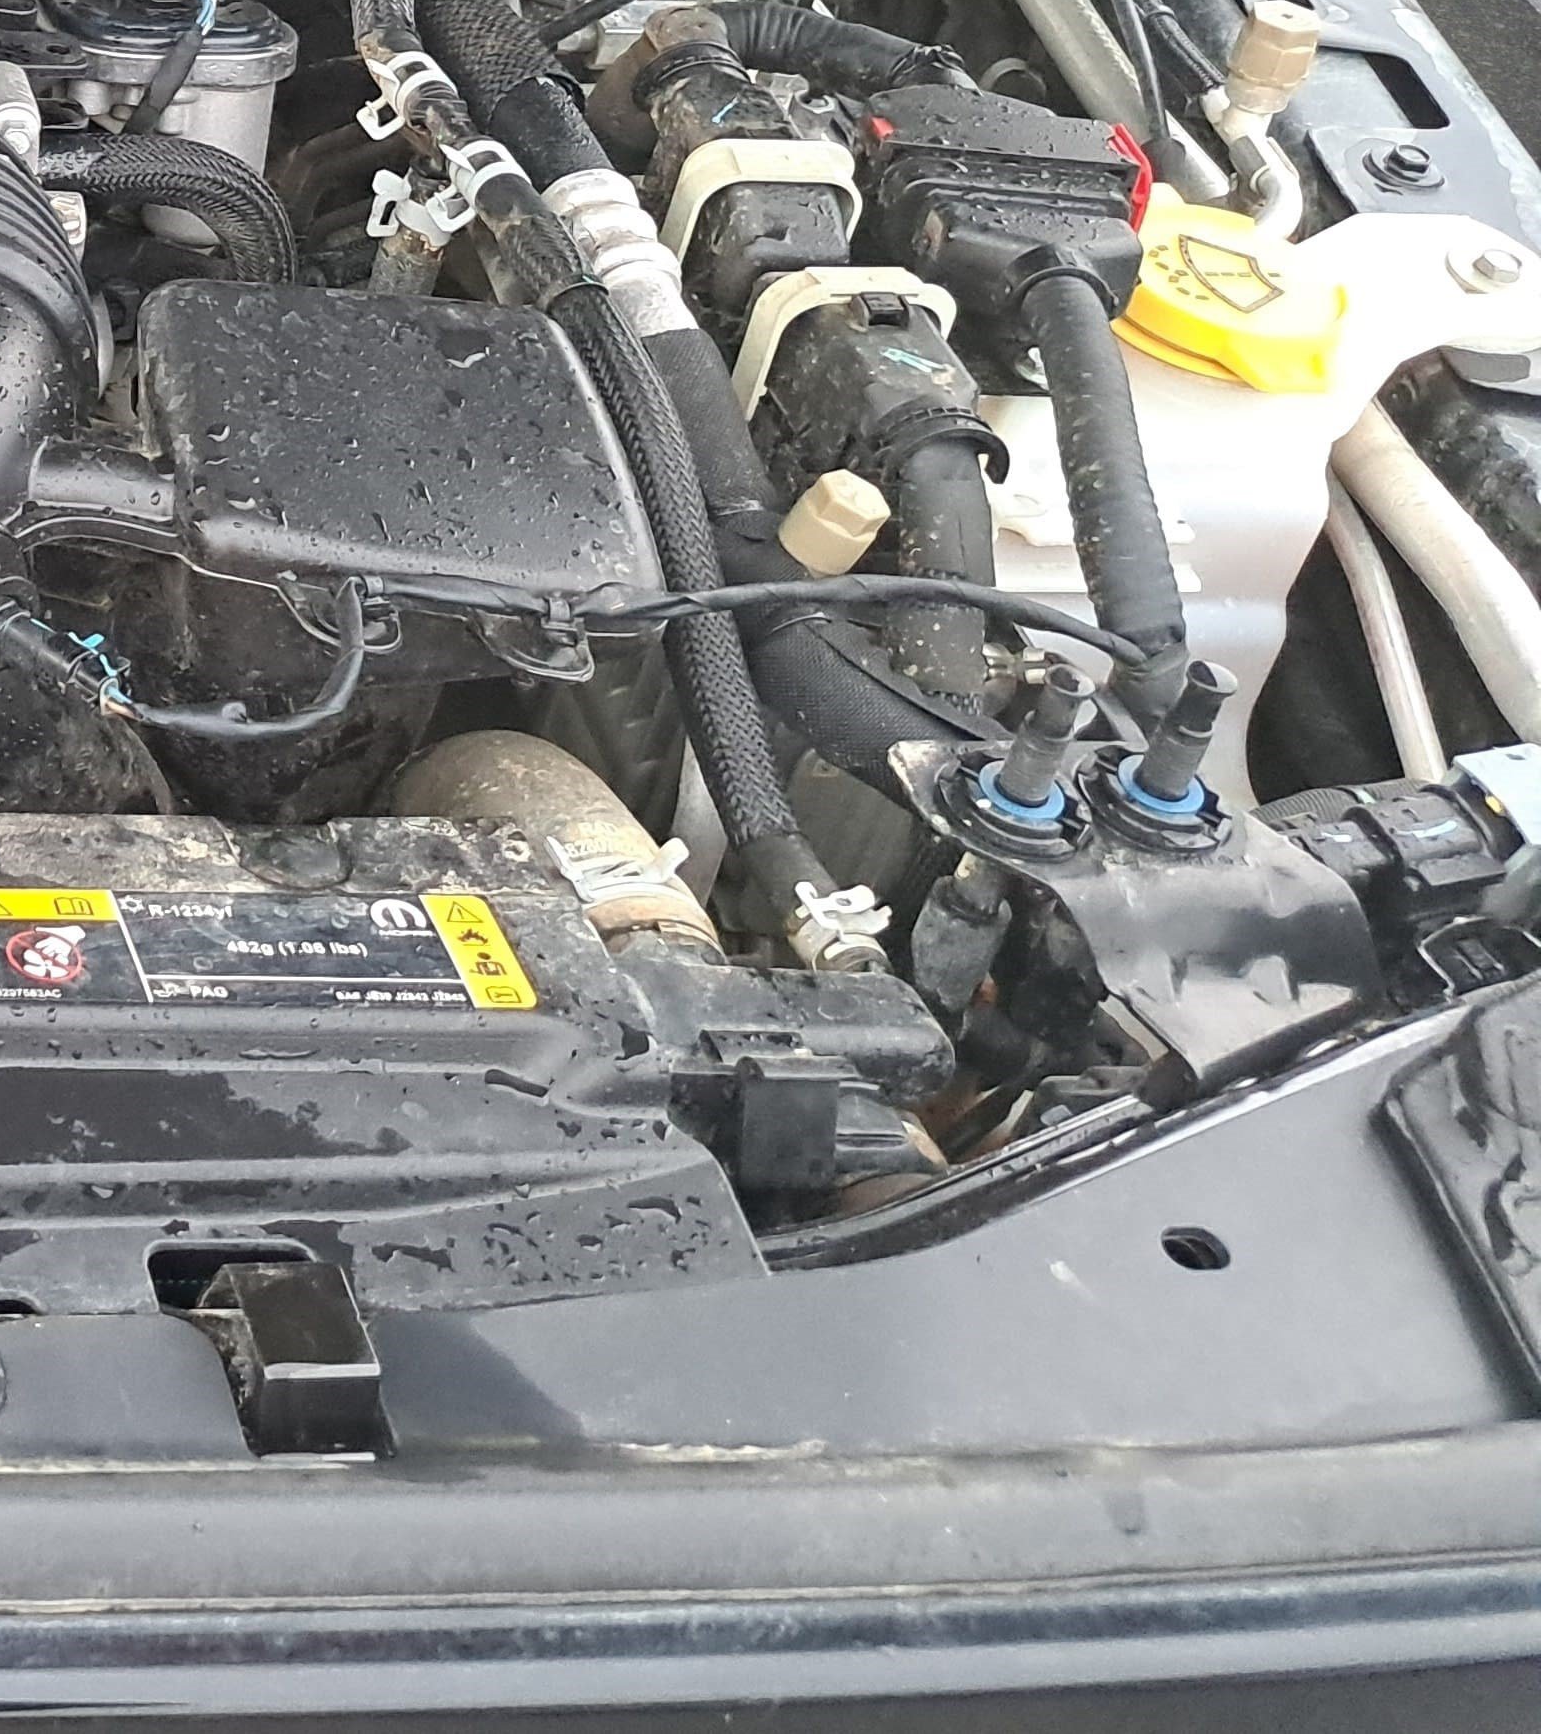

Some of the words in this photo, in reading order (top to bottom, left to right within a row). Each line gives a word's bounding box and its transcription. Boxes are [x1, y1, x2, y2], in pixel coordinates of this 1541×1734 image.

[578, 820, 618, 843] RAD
[329, 942, 368, 958] lbs)
[188, 984, 230, 998] PAG
